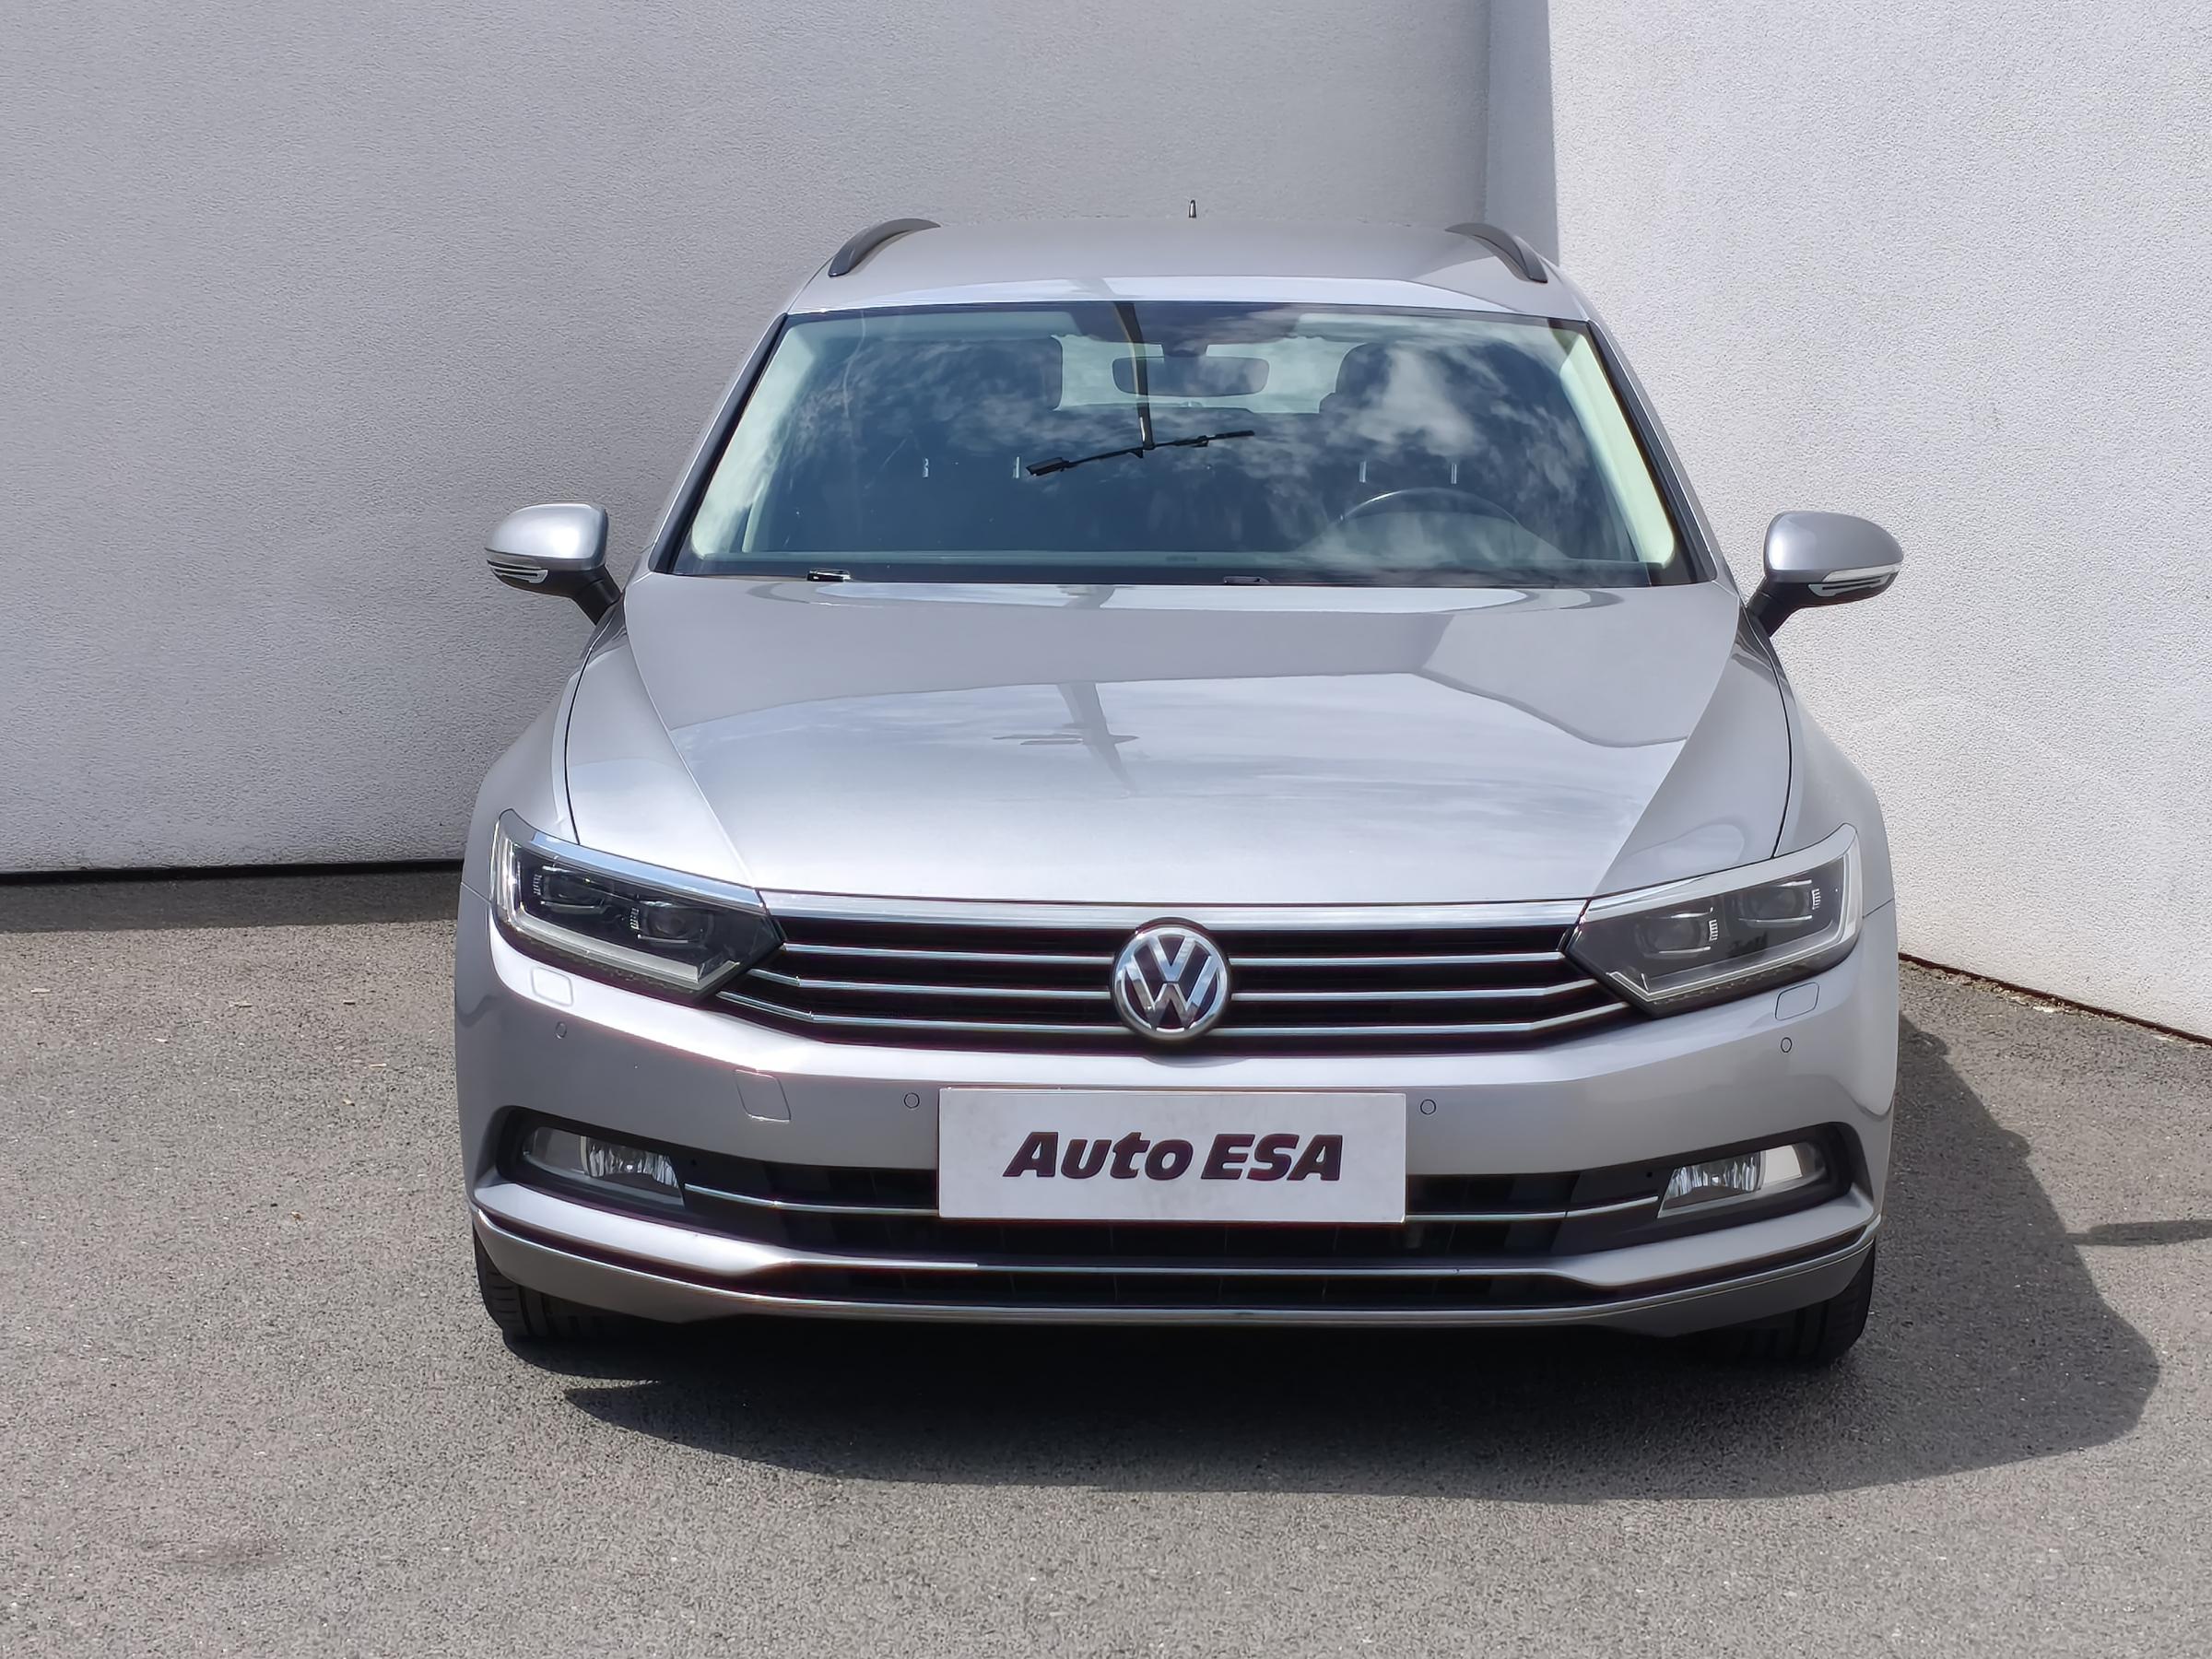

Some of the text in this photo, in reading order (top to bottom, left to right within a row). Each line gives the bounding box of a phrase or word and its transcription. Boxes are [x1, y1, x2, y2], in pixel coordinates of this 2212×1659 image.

[1119, 928, 1226, 1036] VW
[1002, 1131, 1344, 1182] Auto ESA
